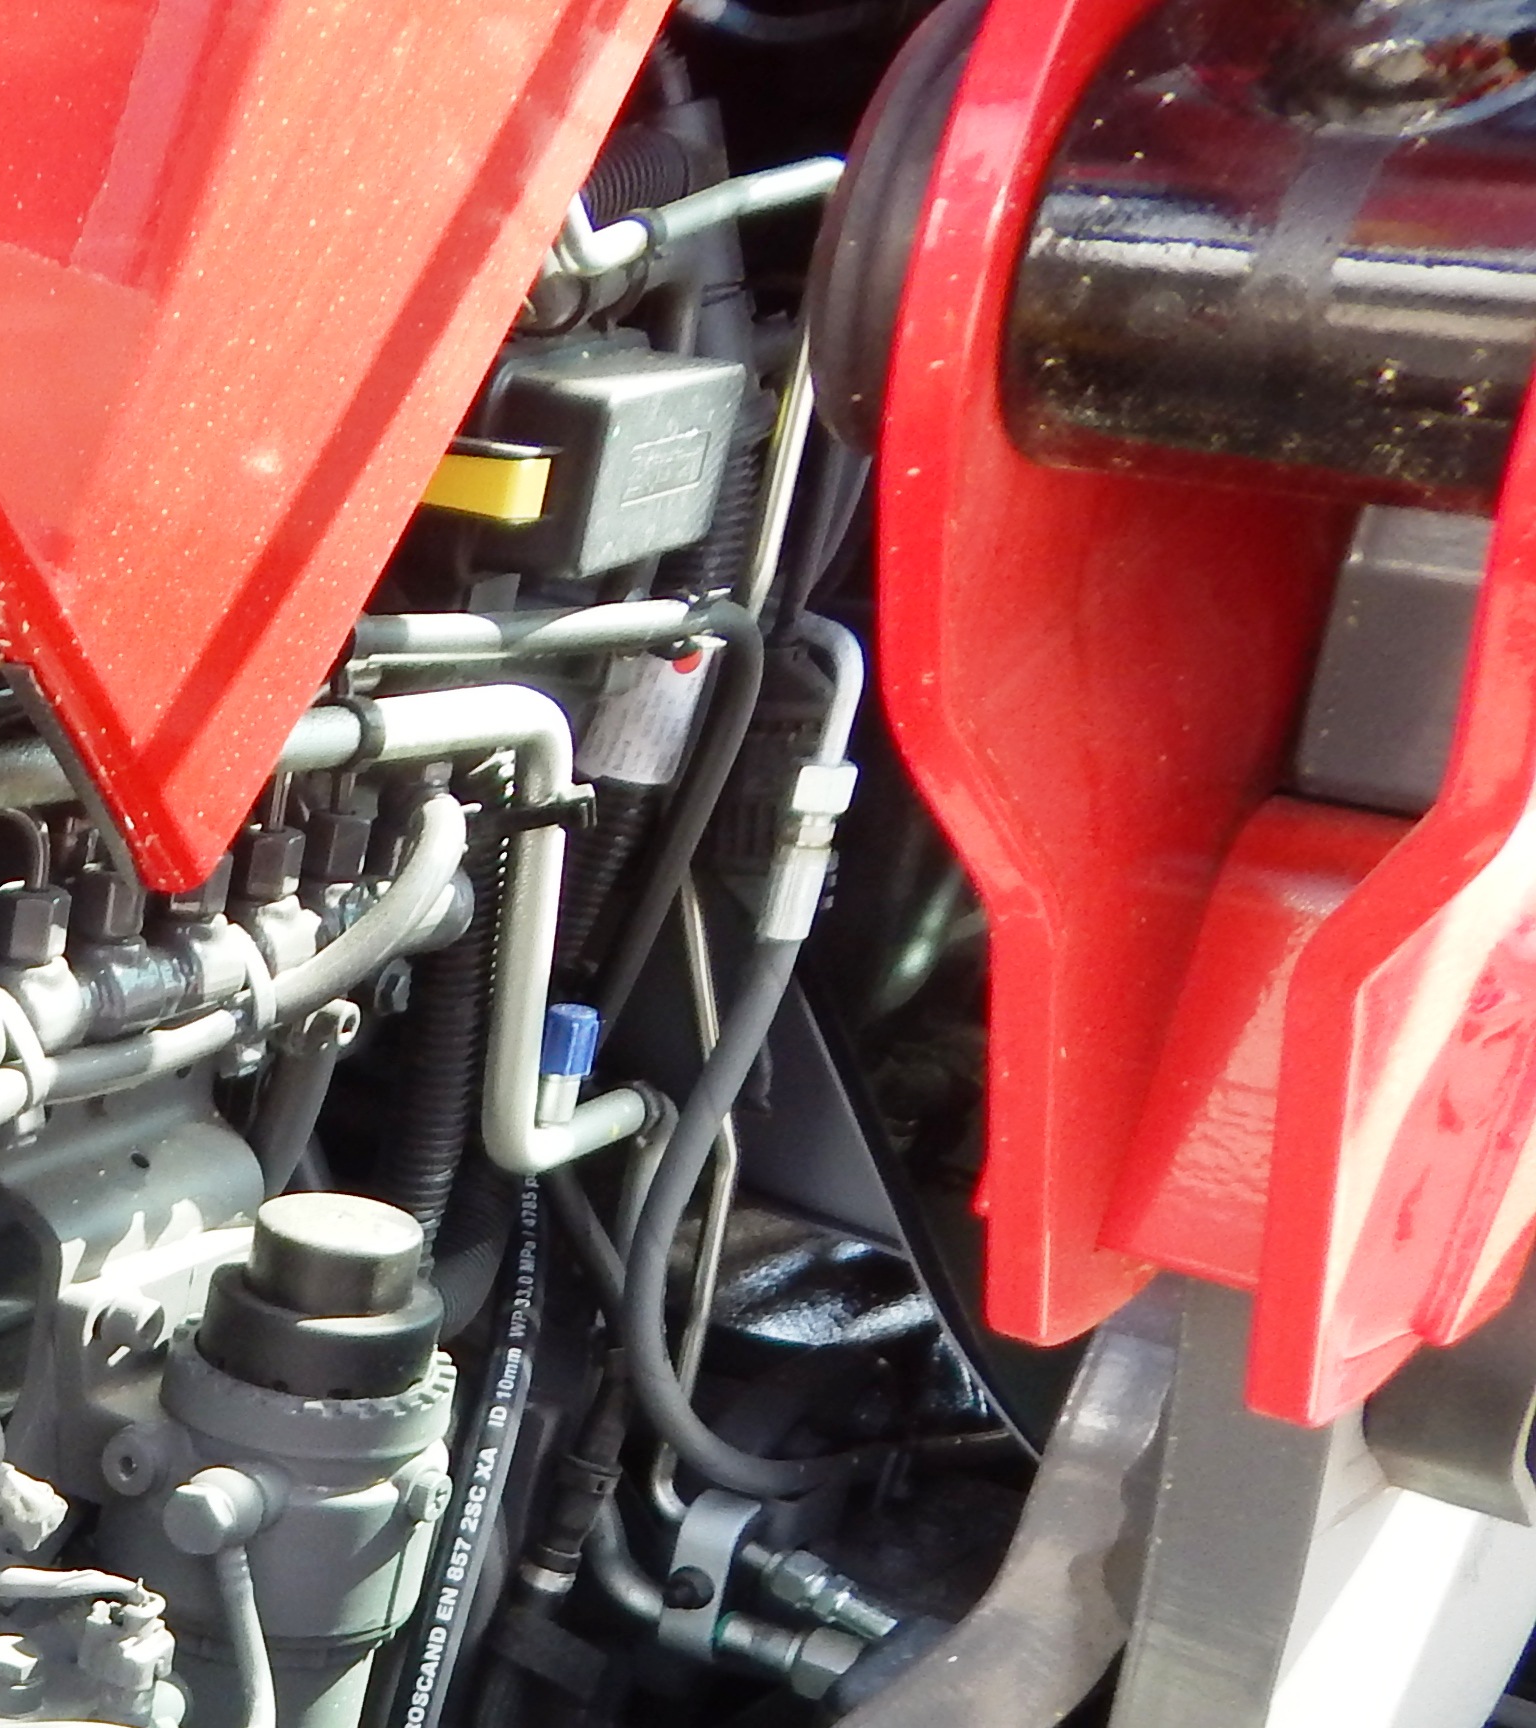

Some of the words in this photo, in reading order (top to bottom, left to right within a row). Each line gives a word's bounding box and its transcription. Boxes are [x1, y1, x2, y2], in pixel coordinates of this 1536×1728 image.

[521, 1191, 539, 1228] 4785
[518, 1240, 538, 1273] MPa
[508, 1309, 528, 1338] WP
[496, 1346, 523, 1400] 10mm
[487, 1405, 508, 1428] ID
[474, 1447, 499, 1482] XA
[460, 1484, 488, 1534] 2SC
[448, 1536, 473, 1582] 857
[435, 1586, 460, 1623] EN
